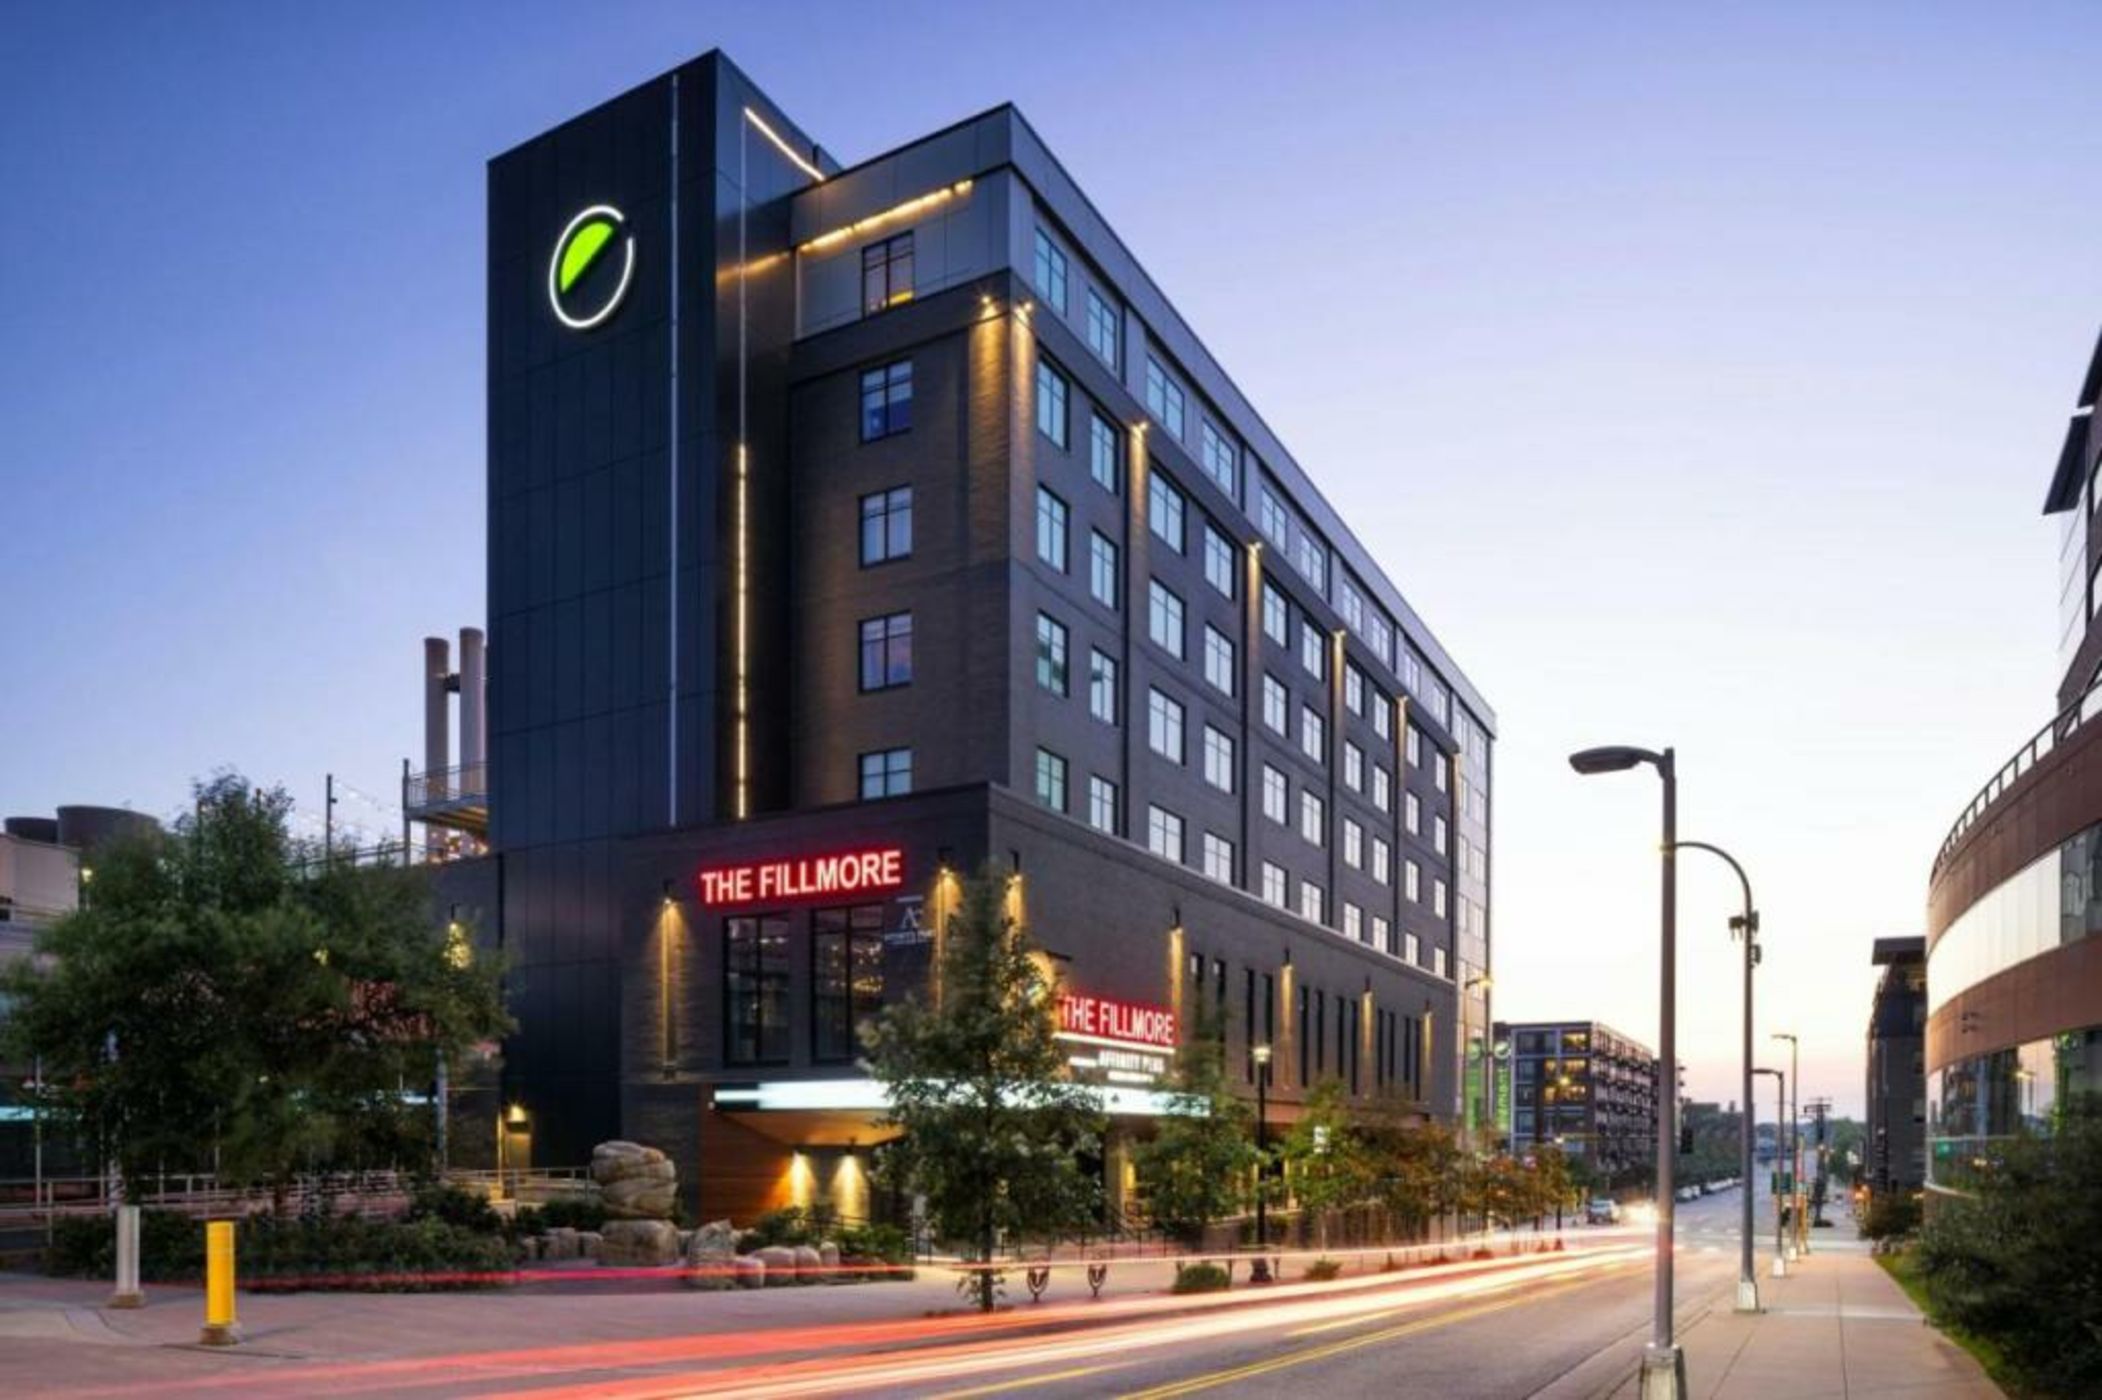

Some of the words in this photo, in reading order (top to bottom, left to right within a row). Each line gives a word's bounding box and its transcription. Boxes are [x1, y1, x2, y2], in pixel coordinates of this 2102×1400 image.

[701, 869, 752, 904] THE
[759, 852, 900, 897] FILLMORE
[1064, 996, 1095, 1032] THE
[1099, 1002, 1173, 1043] FILLMORE
